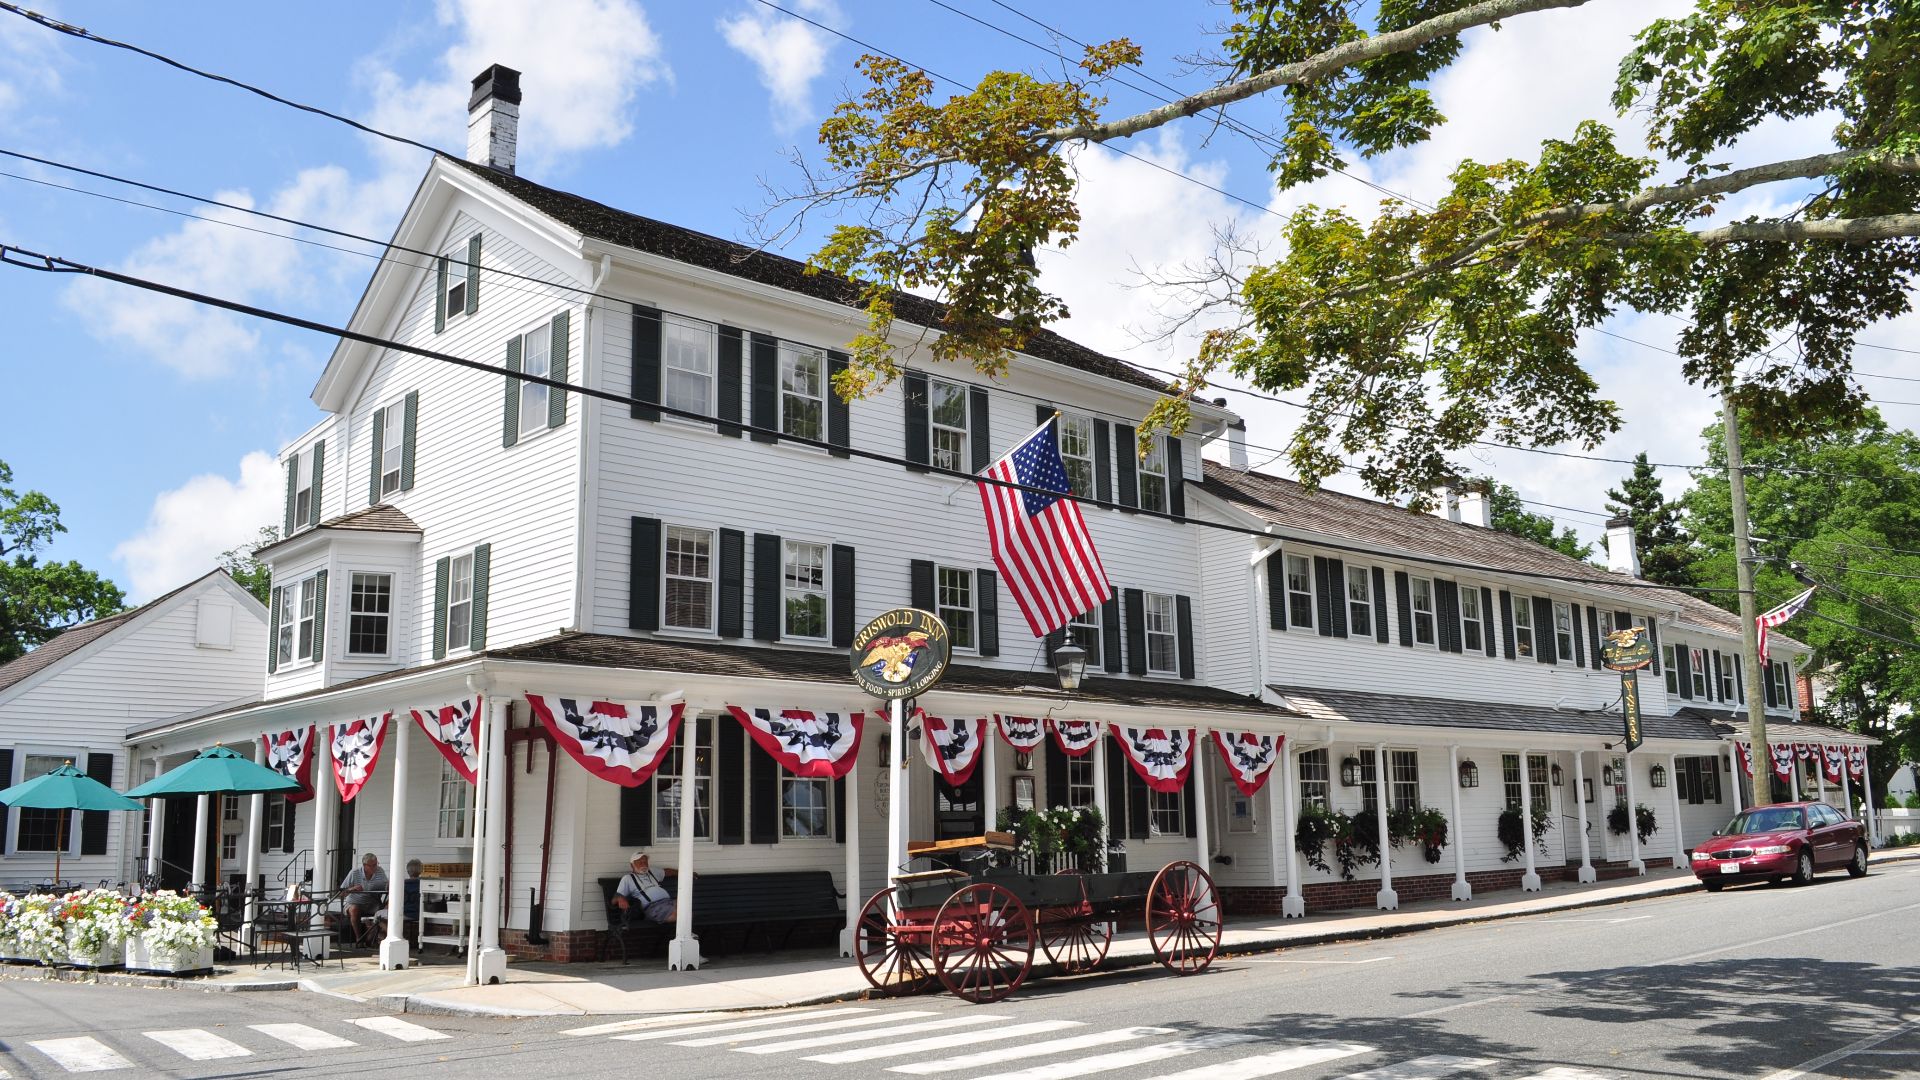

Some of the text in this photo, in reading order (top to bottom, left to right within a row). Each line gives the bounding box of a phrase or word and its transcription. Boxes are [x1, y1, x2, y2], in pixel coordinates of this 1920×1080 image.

[854, 611, 945, 651] GRISWOLD INN
[852, 660, 943, 697] FINE FOOD SPIRITS LODGING
[1623, 680, 1638, 742] WINE BAR
